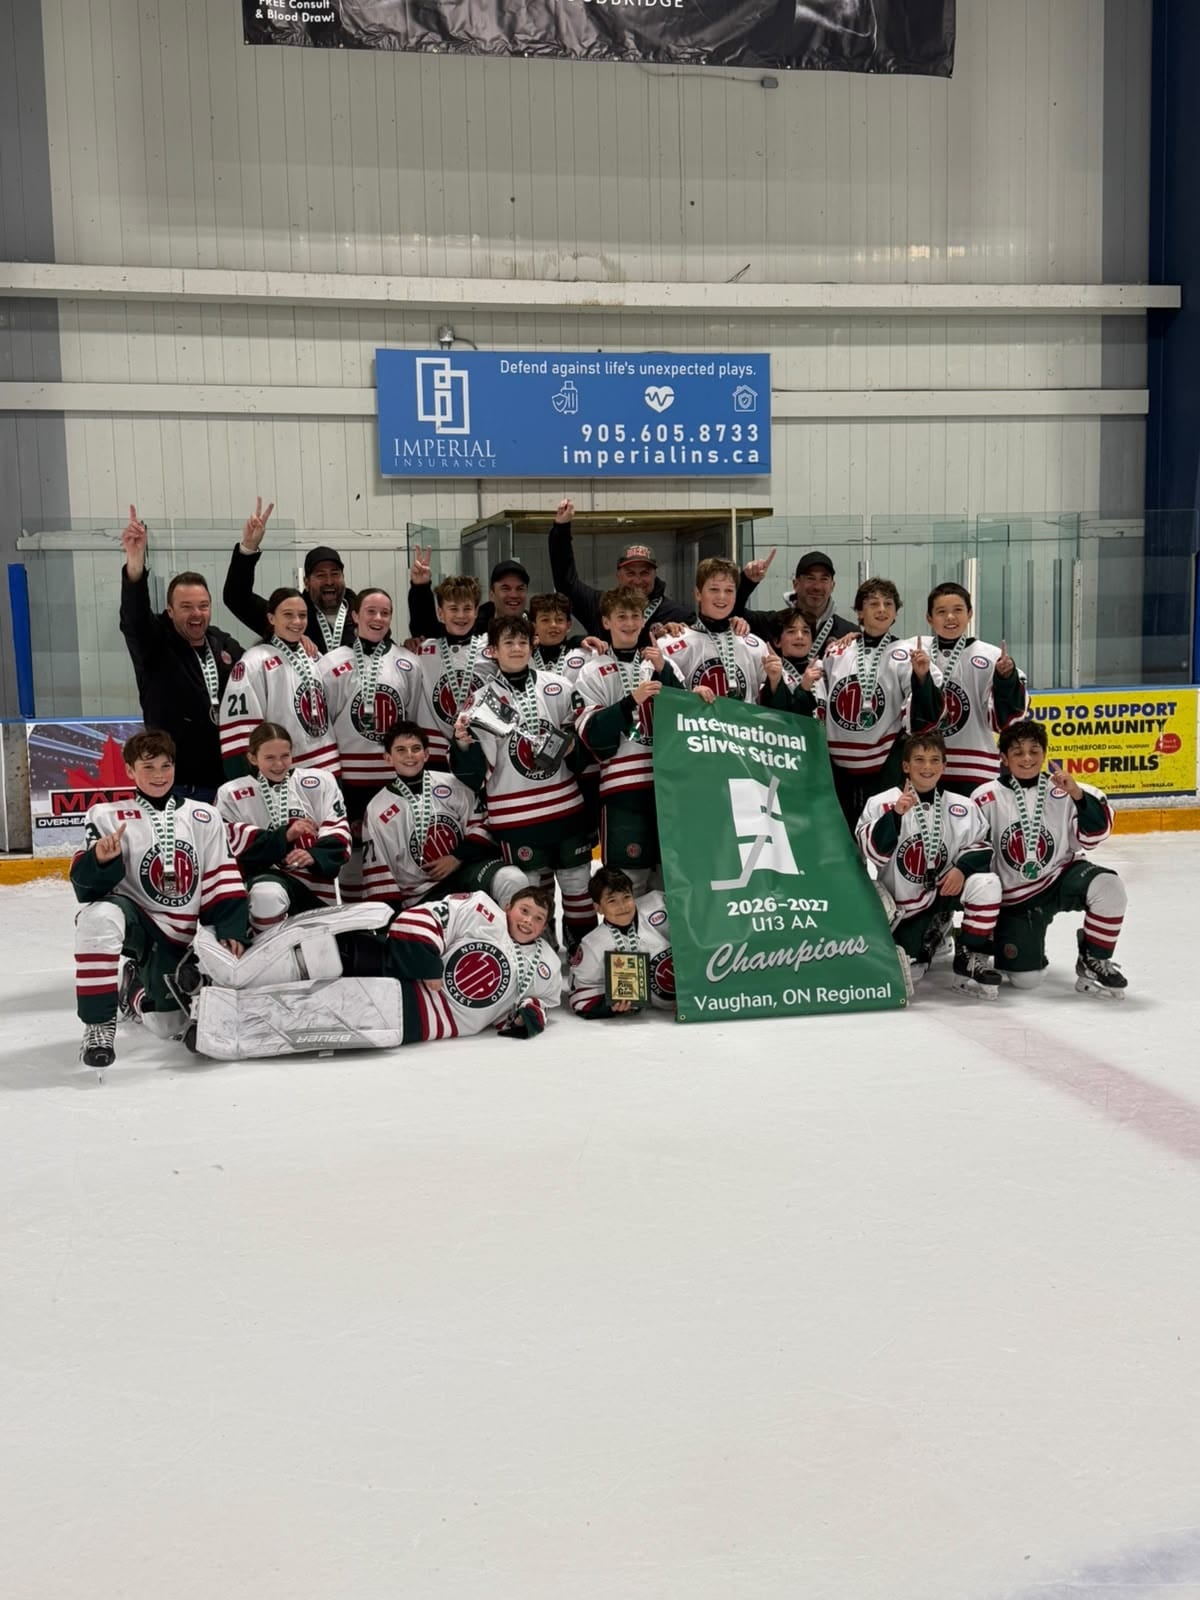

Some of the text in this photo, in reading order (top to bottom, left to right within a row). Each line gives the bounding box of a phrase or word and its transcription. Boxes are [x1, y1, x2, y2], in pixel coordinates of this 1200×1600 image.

[289, 0, 330, 9] Consult
[255, 9, 335, 22] & Blood Draw!
[500, 360, 757, 378] Defend against life's unexpected plays.
[581, 423, 759, 443] 905.605.8733
[394, 438, 496, 458] IMPERIAL
[563, 446, 760, 468] imperialins.ca
[394, 458, 497, 468] INSURANCE
[228, 692, 249, 717] 21
[1065, 705, 1090, 719] TO
[1093, 702, 1177, 718] SUPPORT
[677, 713, 807, 751] International
[1051, 719, 1168, 736] COMMUNITY
[687, 735, 799, 771] Silver Stick
[1063, 743, 1107, 752] RUTHERFORD
[1067, 755, 1160, 773] NOFRILLS
[752, 915, 818, 932] U13 AA
[461, 942, 497, 955] NORTH
[704, 934, 869, 983] Champions
[490, 955, 510, 1002] TORONTO
[445, 970, 473, 1007] HOCKEY
[694, 983, 892, 1013] Vaughan, ON Regional
